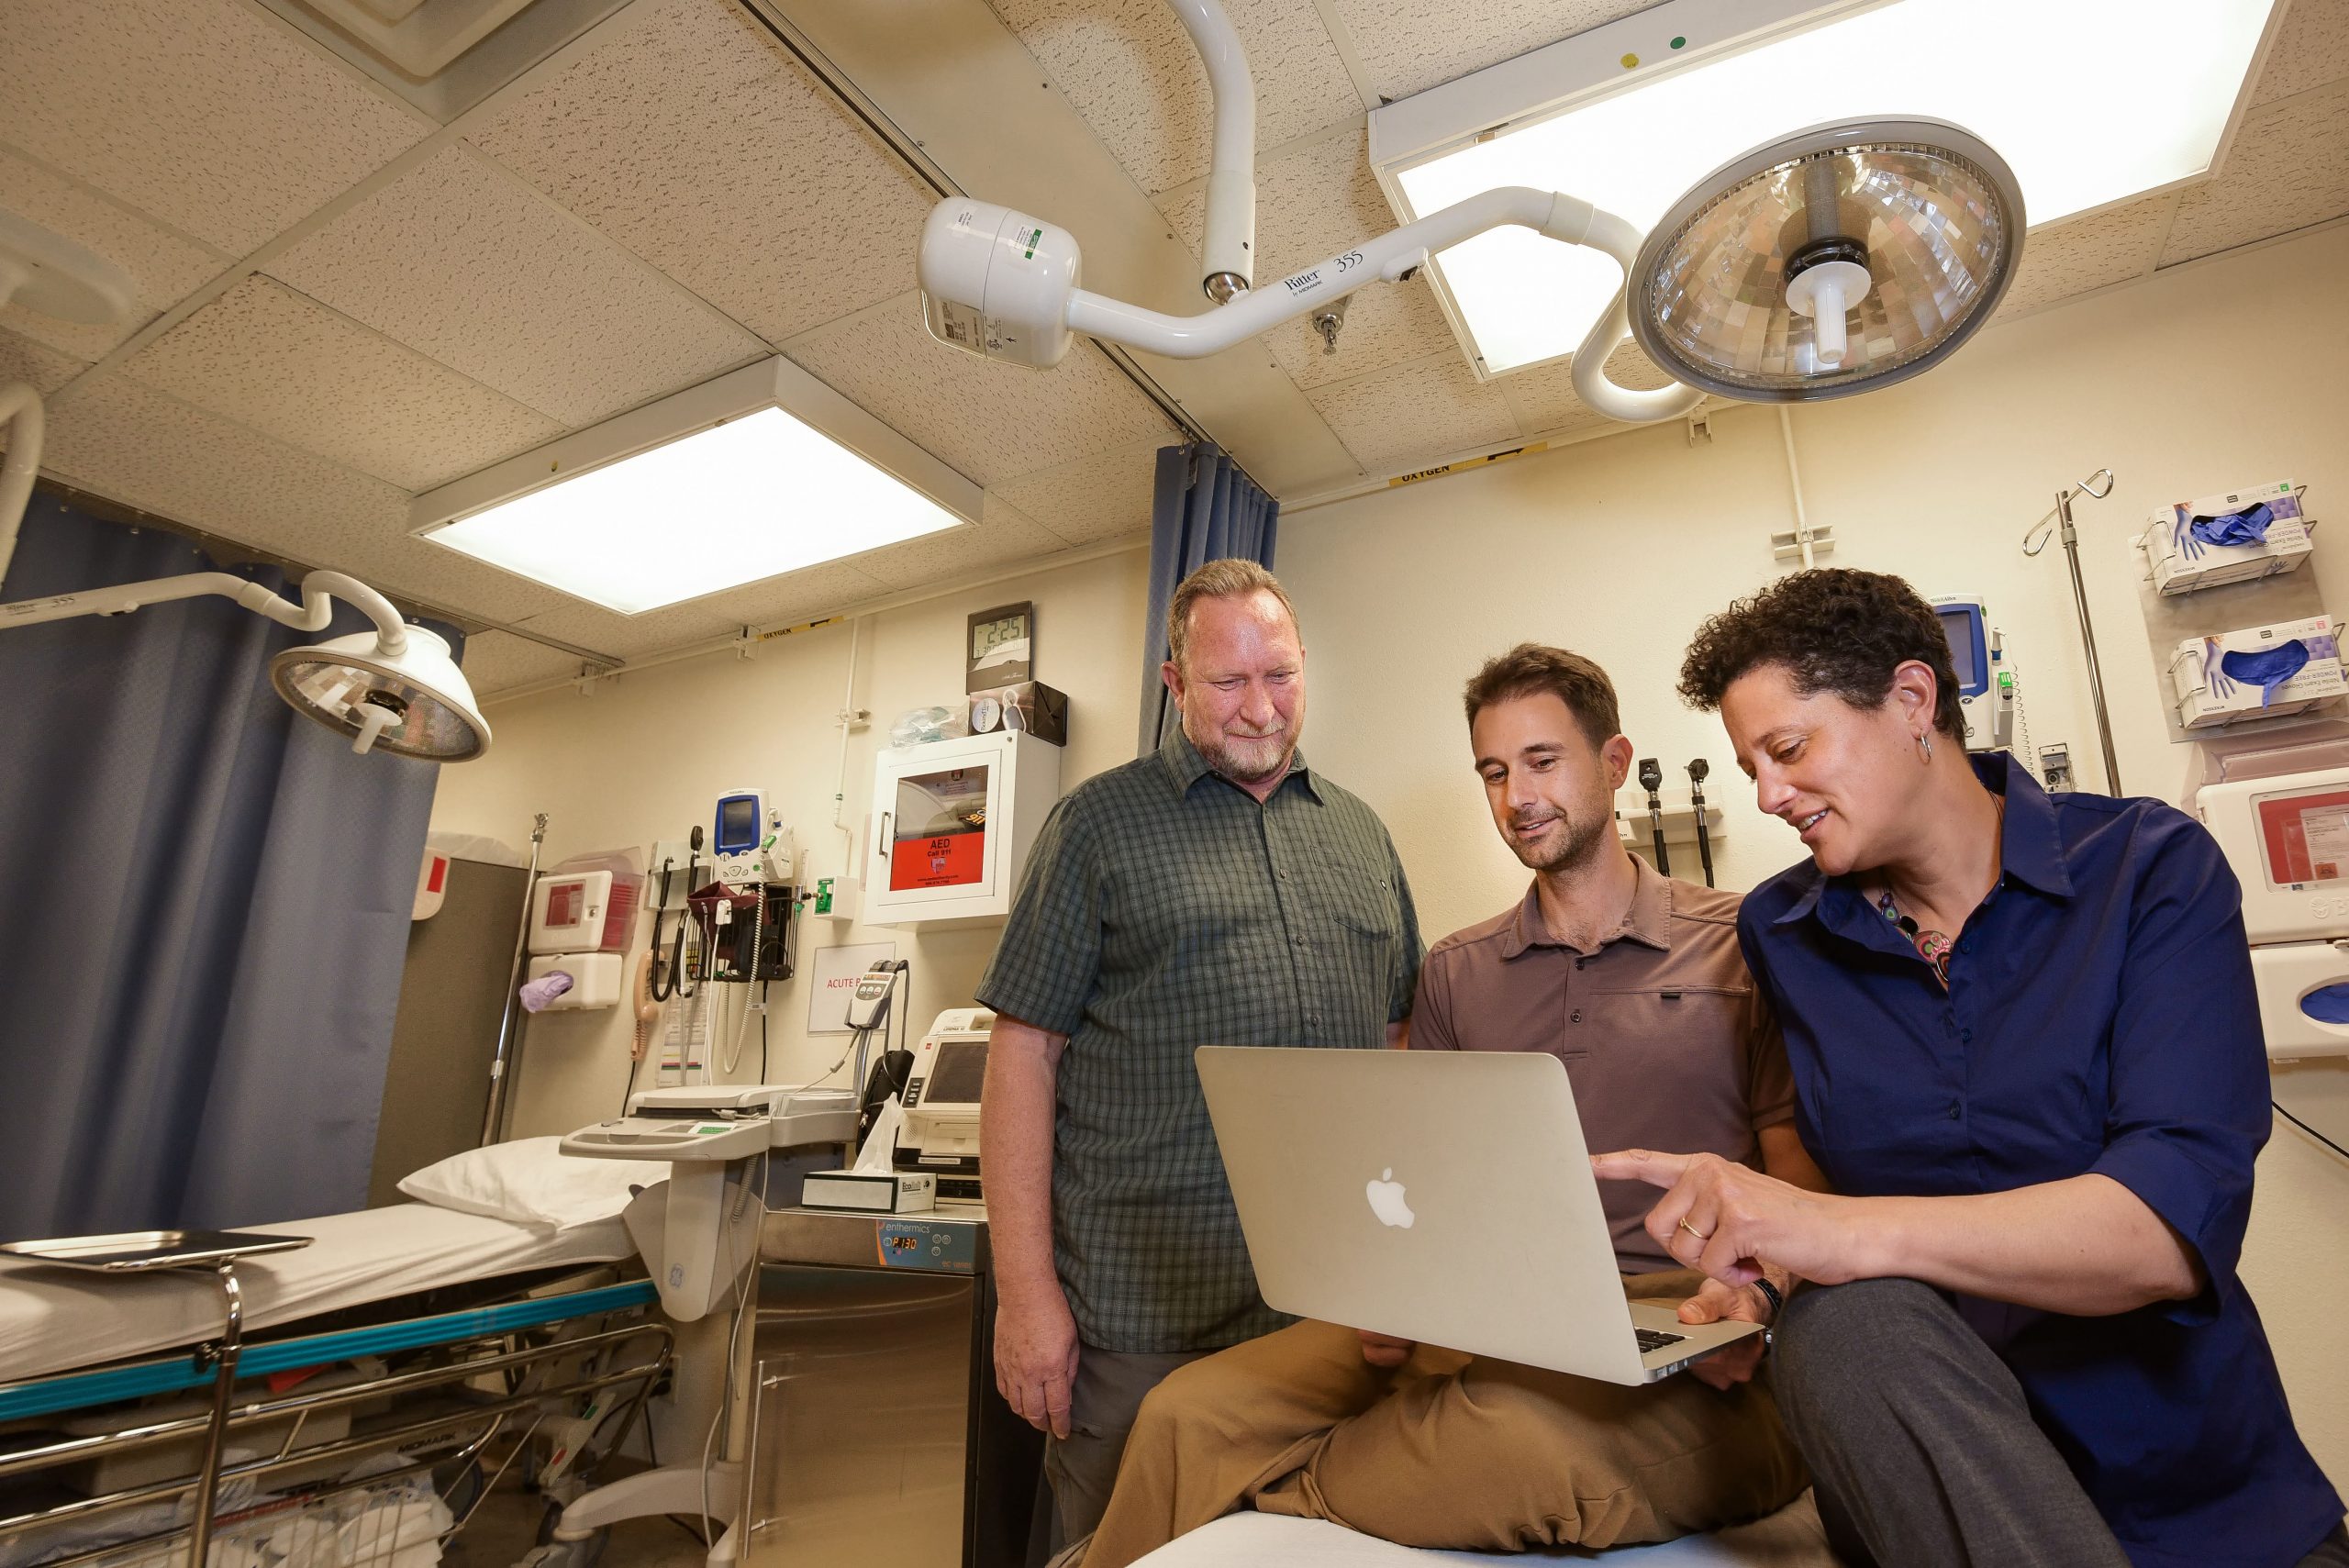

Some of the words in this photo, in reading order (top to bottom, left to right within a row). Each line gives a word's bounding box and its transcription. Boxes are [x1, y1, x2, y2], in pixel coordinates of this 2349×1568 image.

[1285, 270, 1319, 290] Ritter
[1333, 250, 1364, 272] 355
[1298, 280, 1323, 295] MIDMARK
[1402, 465, 1450, 482] OXYGEN
[763, 628, 792, 639] OXYGEN
[930, 839, 951, 850] AED
[827, 978, 853, 988] ACUTE
[885, 1222, 930, 1234] enthermics
